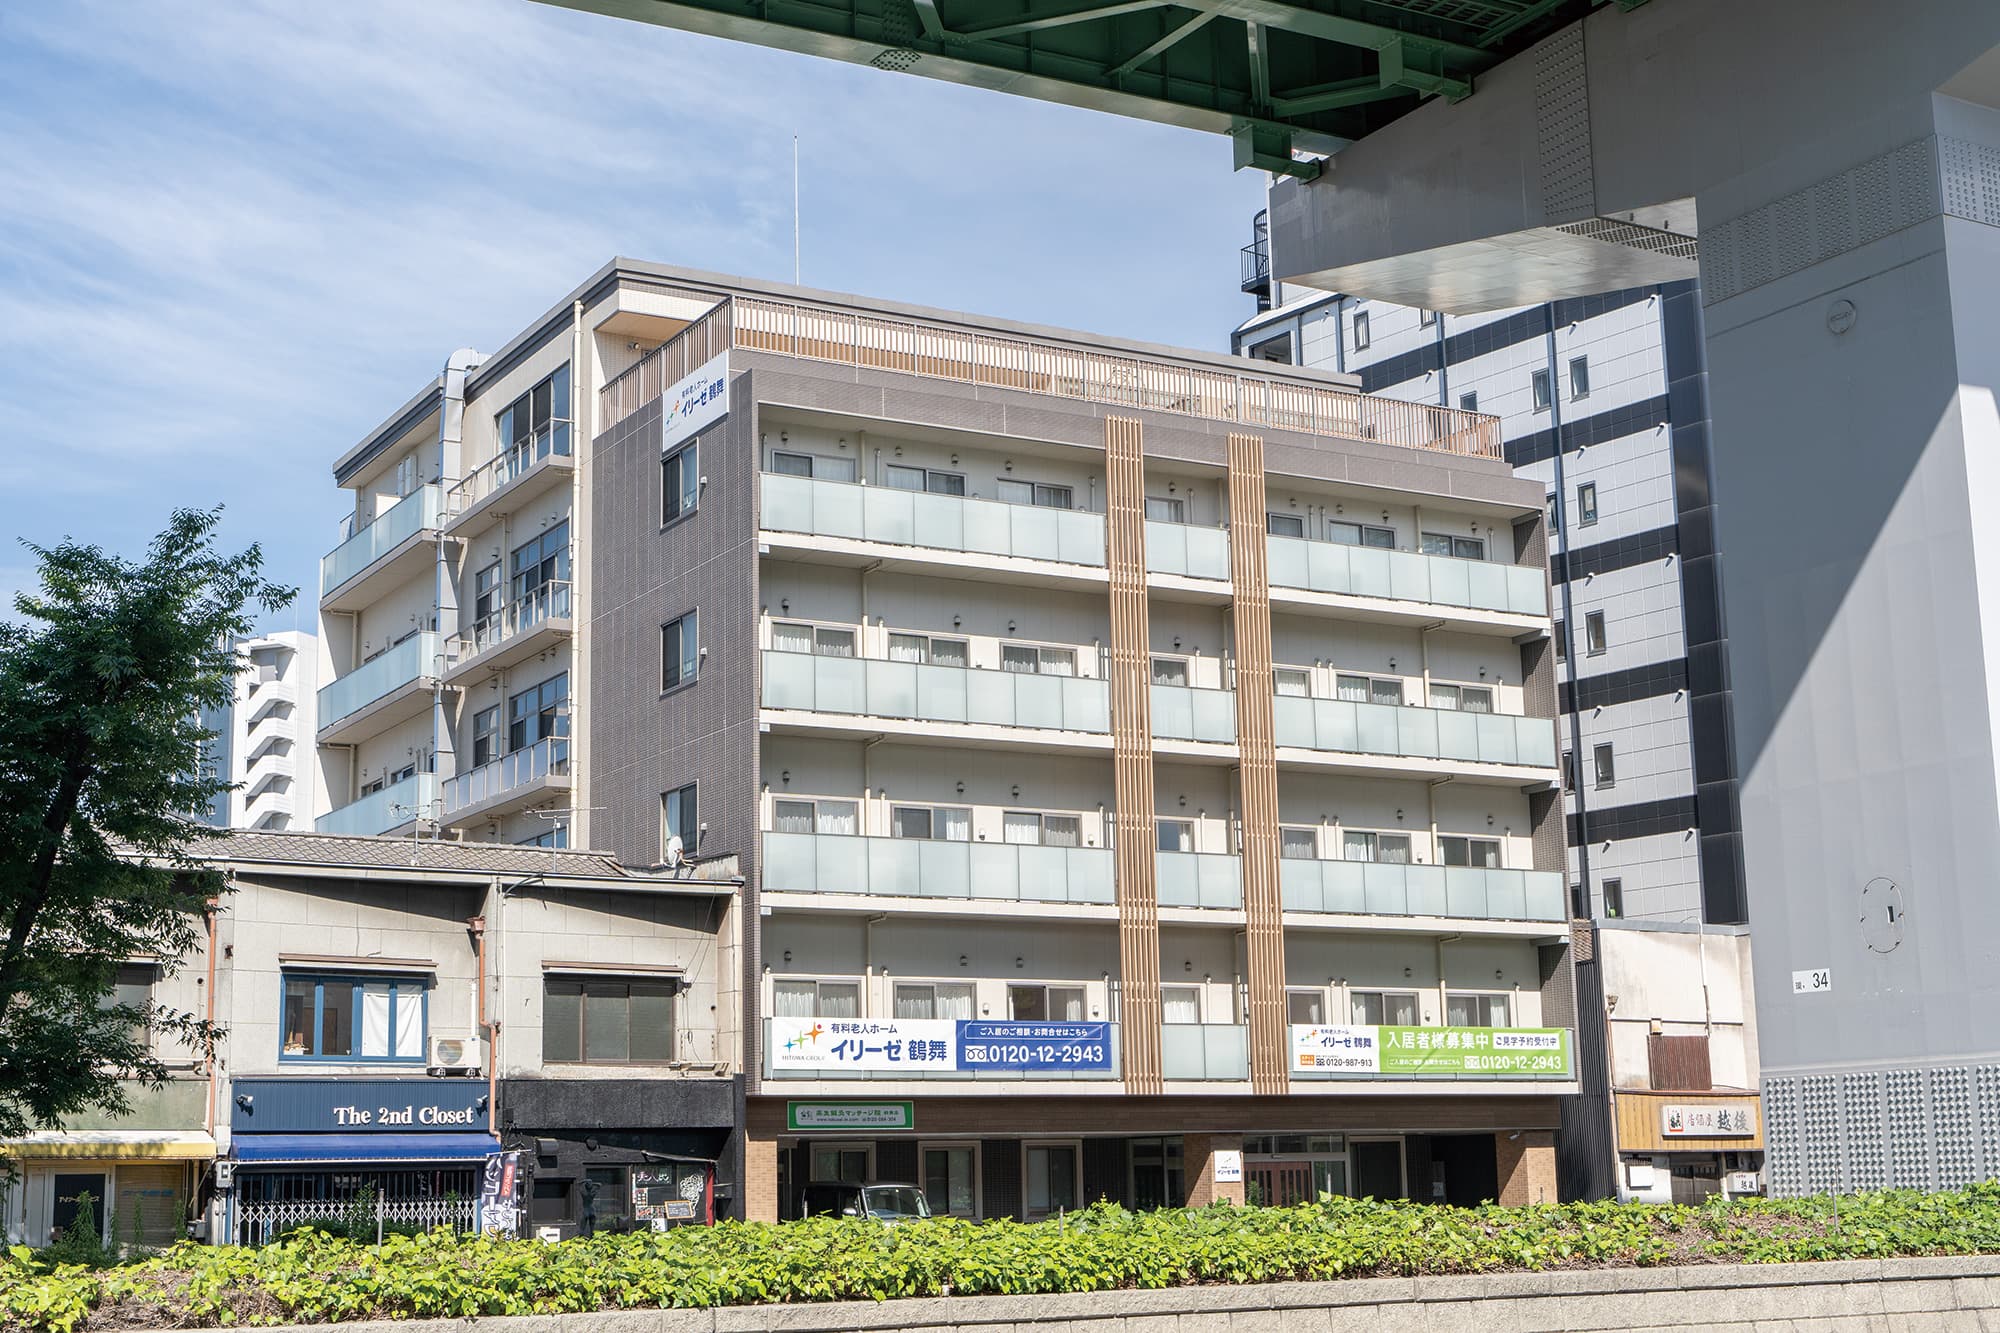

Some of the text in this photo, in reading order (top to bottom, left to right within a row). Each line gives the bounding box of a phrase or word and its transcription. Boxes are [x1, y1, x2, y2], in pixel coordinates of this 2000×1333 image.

[682, 388, 707, 417] イリーゼ
[1812, 972, 1828, 988] 34
[831, 1023, 898, 1034] 有料老人ホーム
[1320, 1036, 1352, 1048] イリーゼ
[1386, 1031, 1557, 1050] 入居者様募集中 ご見学予約受付中
[831, 1039, 948, 1062] イリーゼ 鶴舞
[989, 1045, 1104, 1063] 0120-12-2943
[1326, 1058, 1373, 1067] 0120-987-913
[1481, 1055, 1562, 1070] 0120-12-2943
[333, 1105, 475, 1125] The 2nd Closet
[1717, 1109, 1750, 1131] 越後
